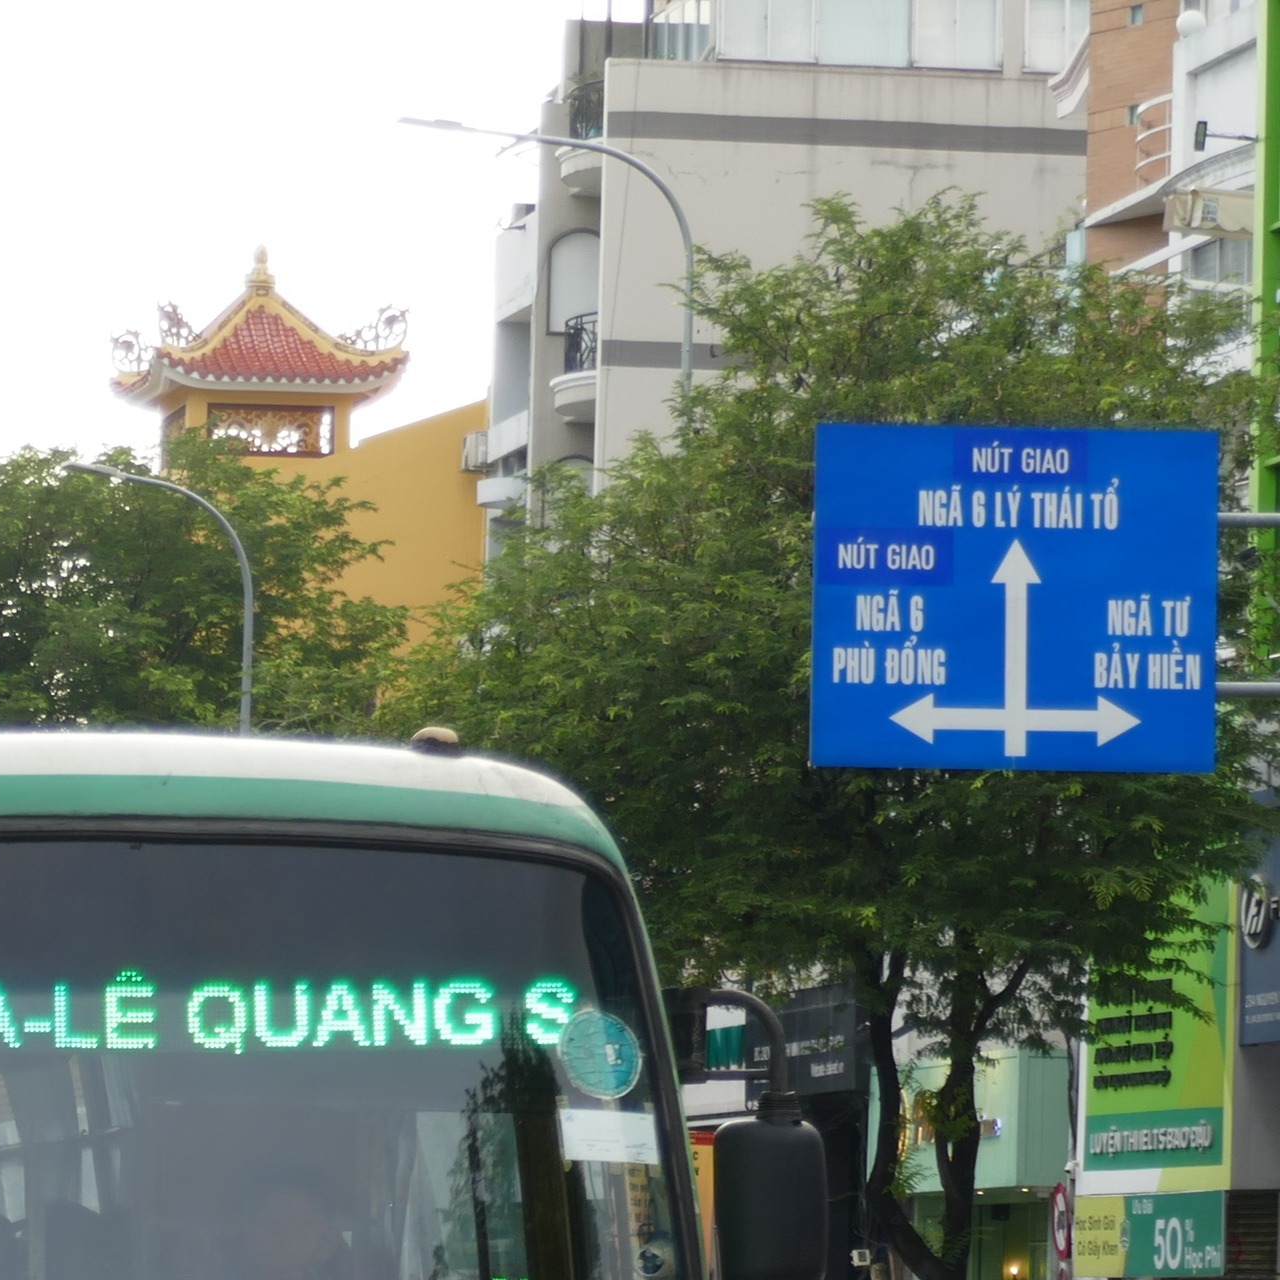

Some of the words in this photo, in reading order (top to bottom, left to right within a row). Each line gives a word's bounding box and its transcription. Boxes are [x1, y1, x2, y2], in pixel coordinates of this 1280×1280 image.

[972, 440, 1013, 473] NÚT
[1021, 447, 1070, 474] GIAO
[918, 486, 963, 527] NGÃ
[971, 491, 986, 528] 6
[995, 484, 1020, 528] LÝ
[1031, 484, 1083, 529] THÁI
[1091, 478, 1119, 530] TỔ
[838, 537, 878, 569] NÚT
[886, 544, 935, 570] GIAO
[856, 589, 900, 632] NGÃ
[909, 594, 924, 632] 6
[1107, 593, 1151, 636] NGÃ
[1164, 596, 1191, 637] TƯ
[832, 640, 875, 684] PHÙ
[885, 635, 946, 685] ĐỔNG
[1094, 642, 1140, 689] BẢY
[1148, 639, 1201, 690] HIỀN
[188, 982, 494, 1055] QUANG
[1153, 1217, 1182, 1270] 50
